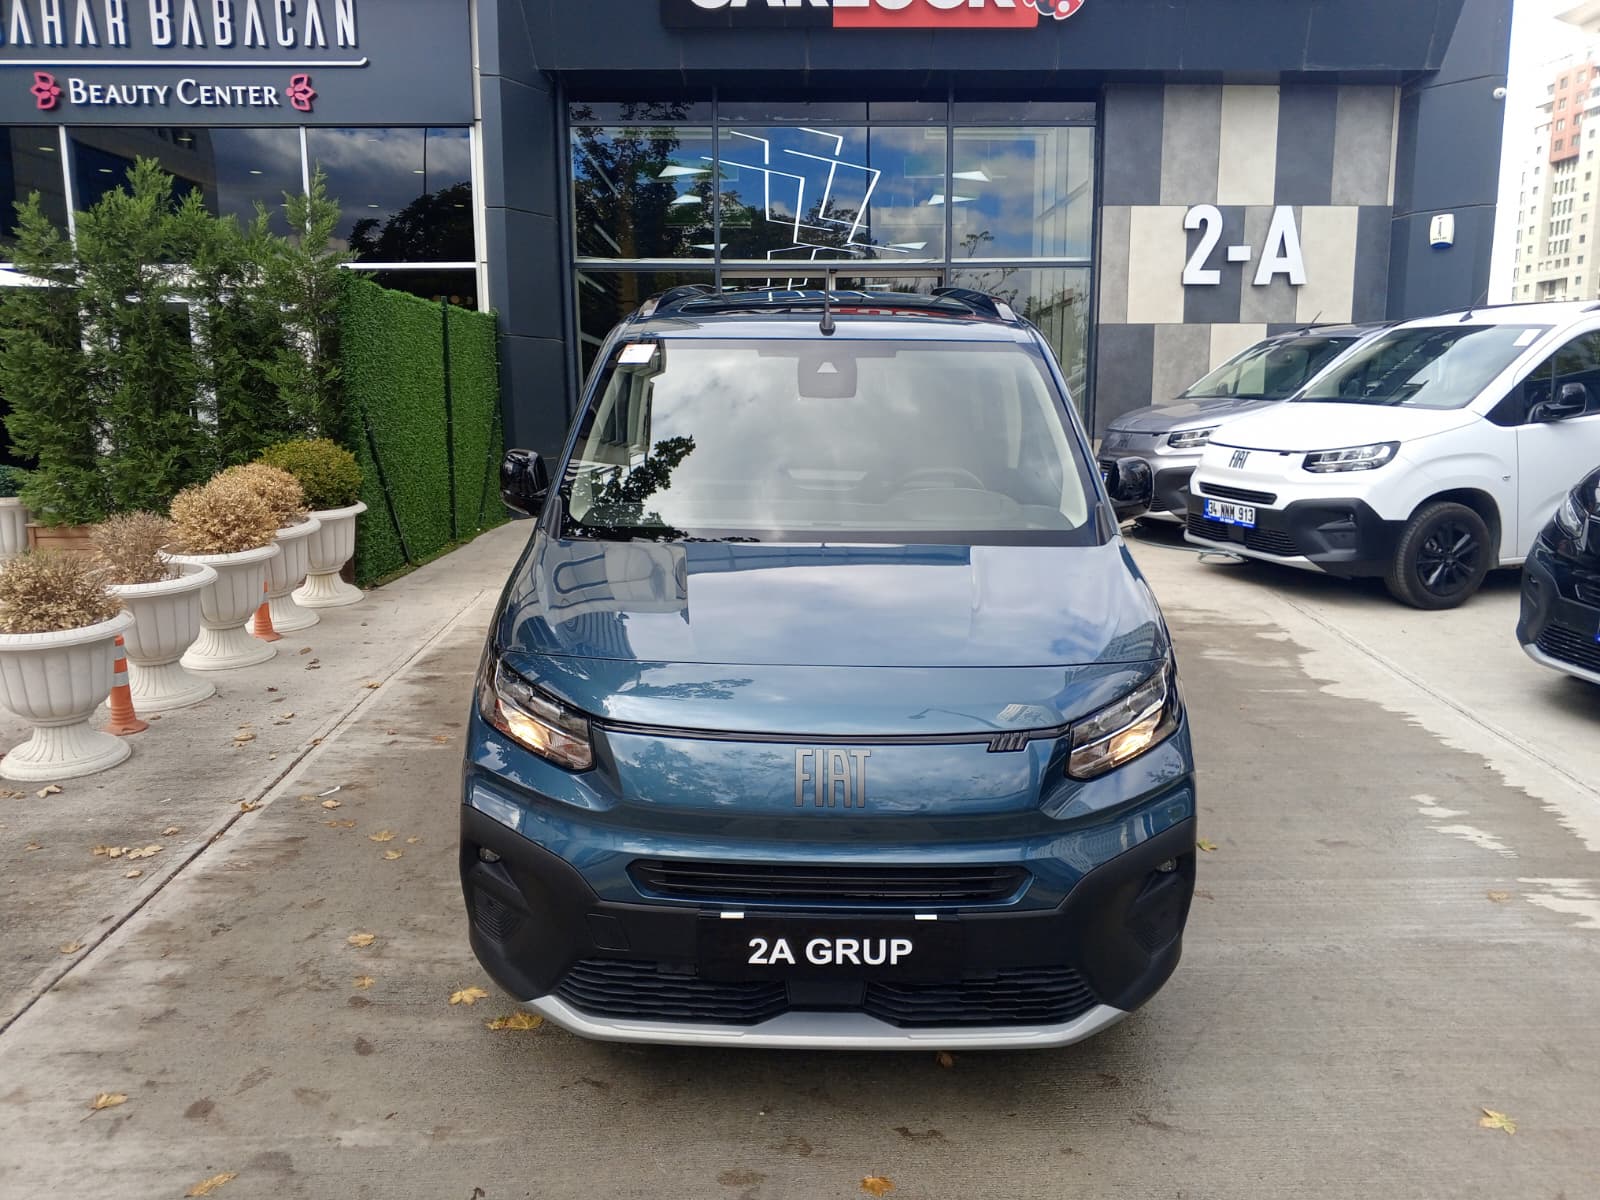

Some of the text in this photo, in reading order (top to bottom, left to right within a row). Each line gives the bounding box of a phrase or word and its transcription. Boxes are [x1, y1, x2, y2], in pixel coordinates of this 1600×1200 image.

[150, 0, 356, 46] BABACAN
[68, 78, 279, 105] BEAUTY CENTER
[1182, 204, 1307, 285] 2-A
[1228, 449, 1251, 469] FIAT
[1208, 501, 1217, 515] 34
[1238, 507, 1254, 522] 913
[794, 748, 871, 808] FIAT
[747, 938, 913, 965] 2A GRUP
